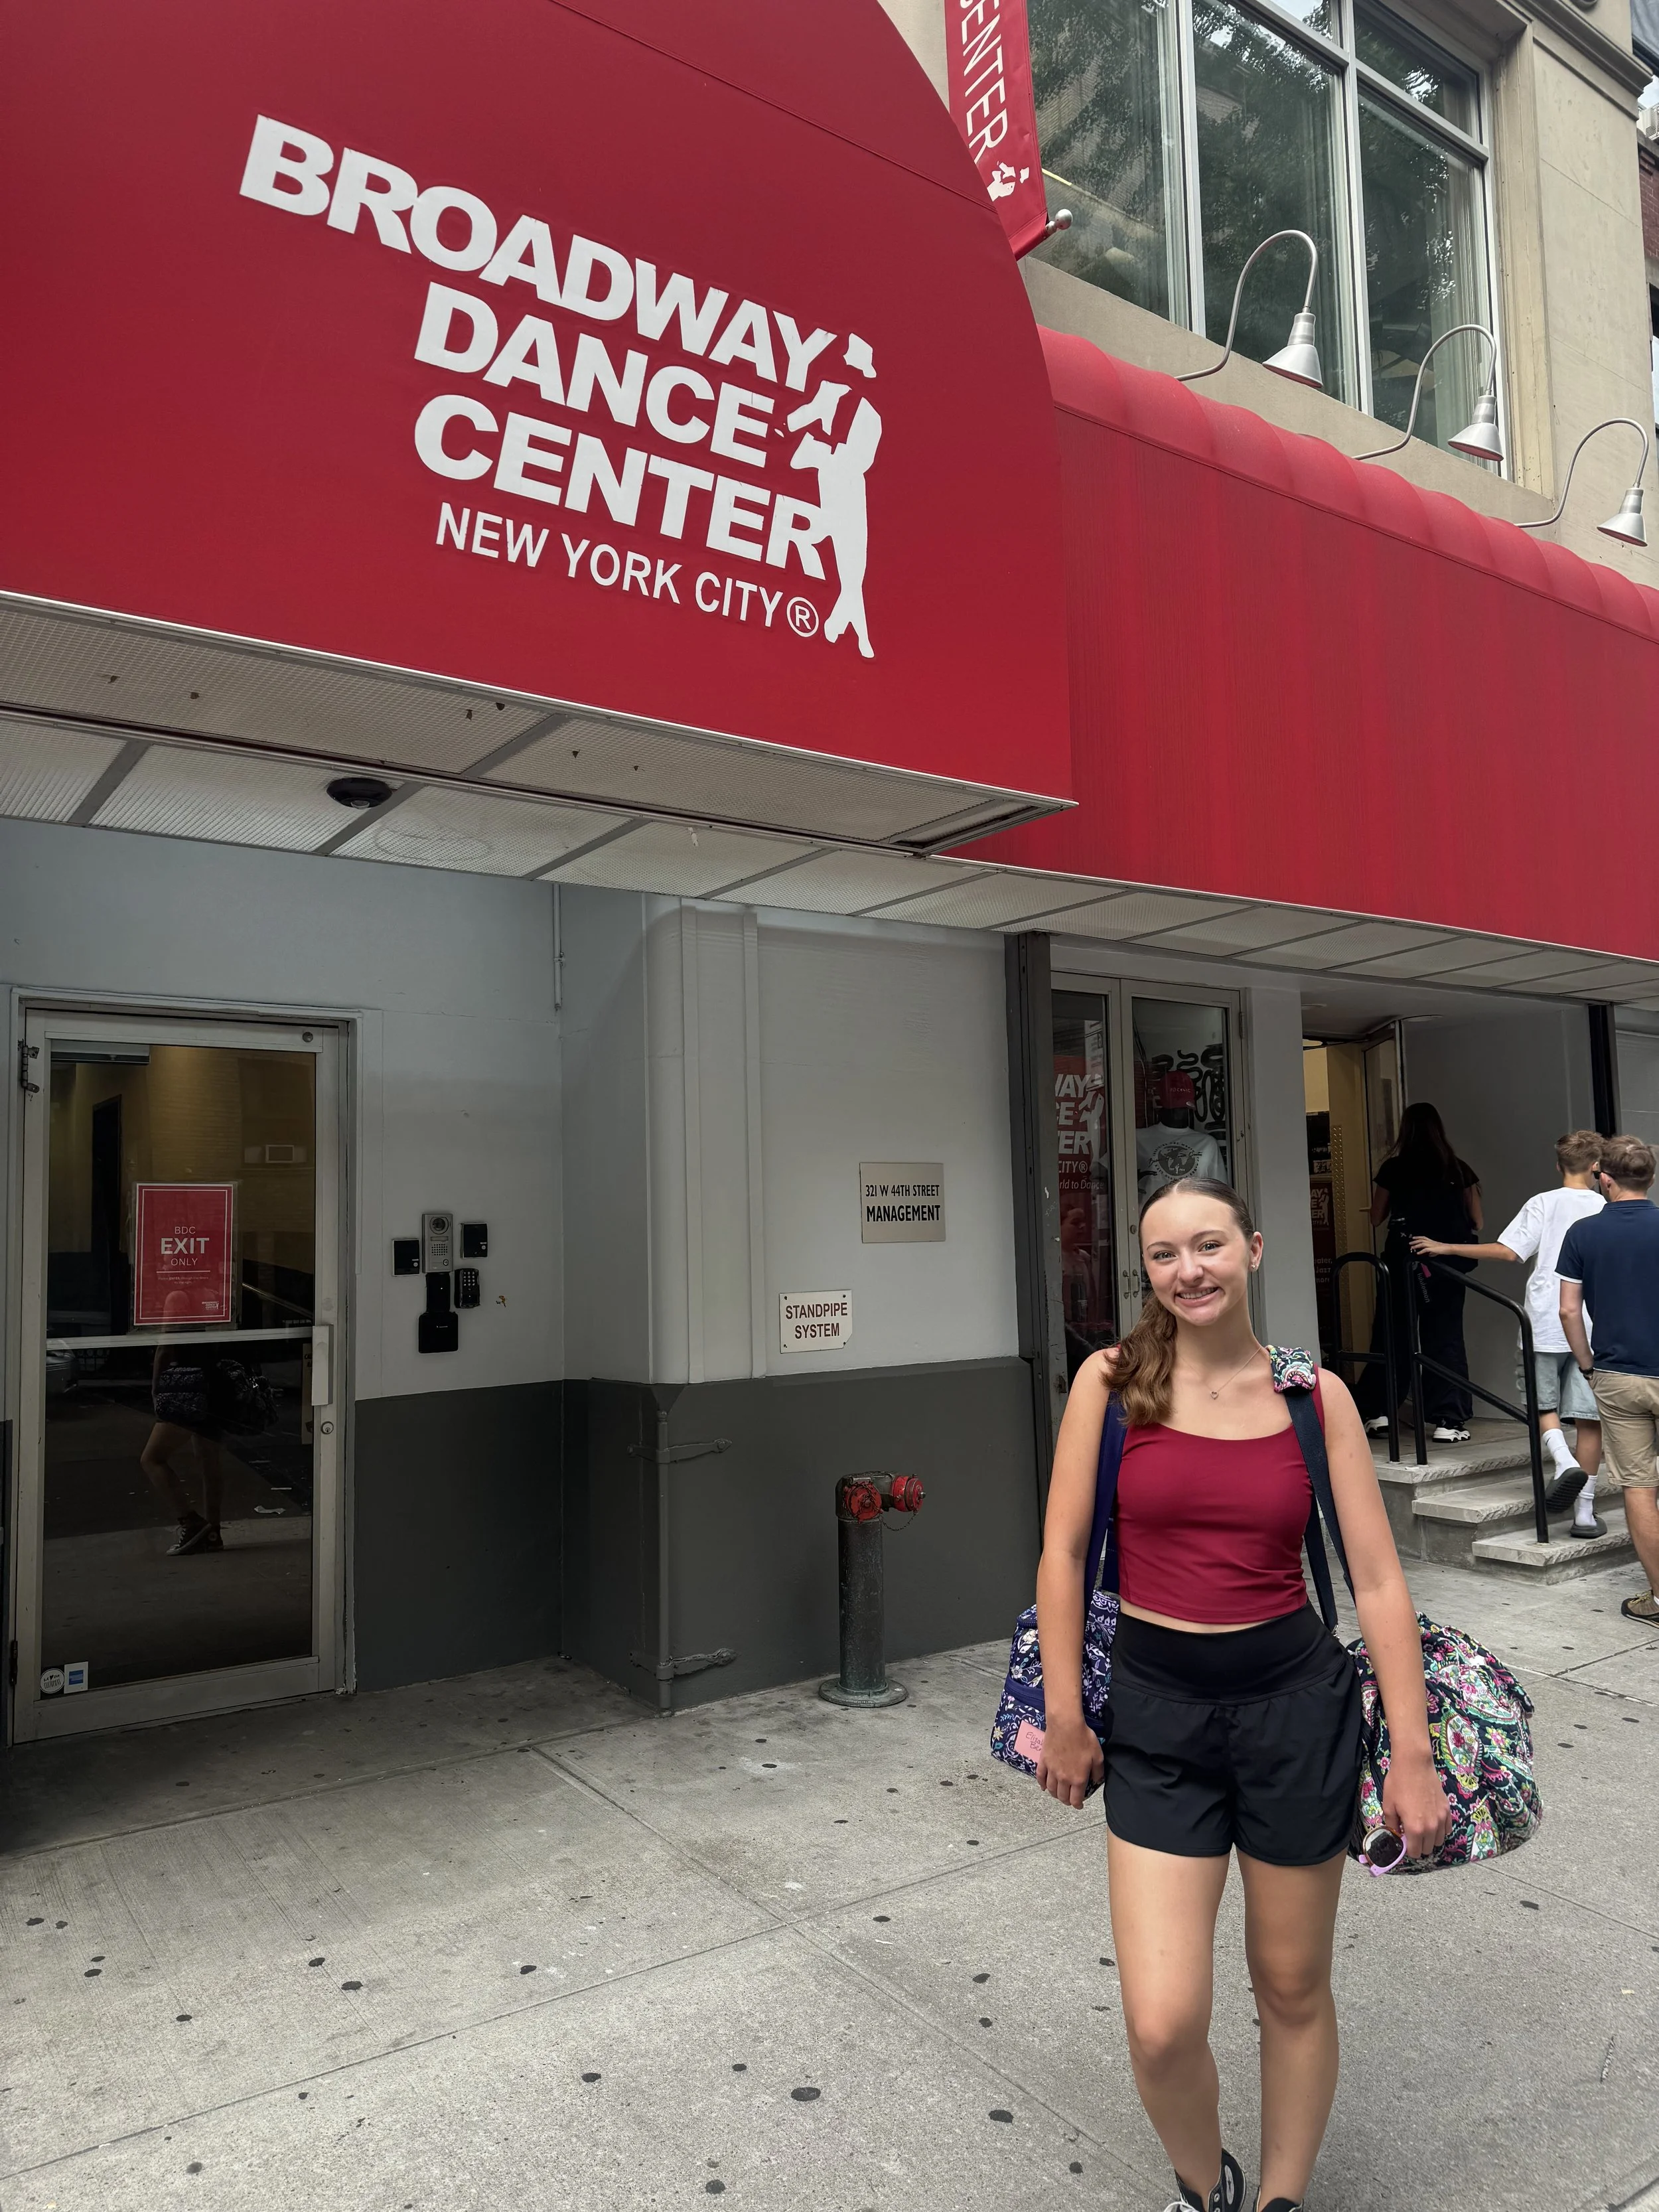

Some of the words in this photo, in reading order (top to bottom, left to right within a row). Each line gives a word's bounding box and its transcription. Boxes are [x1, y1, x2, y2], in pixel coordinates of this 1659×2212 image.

[240, 114, 837, 392] BROADWAY
[414, 282, 774, 468] DANCE
[414, 394, 830, 579] CENTER
[436, 502, 549, 567] NEW
[560, 533, 682, 605] YORK
[865, 1185, 877, 1197] 321
[879, 1185, 889, 1197] W
[891, 1185, 910, 1197] 44TH
[912, 1185, 940, 1197] STREET
[1070, 1180, 1080, 1190] to
[1080, 1179, 1105, 1190] Dance
[866, 1205, 941, 1222] MANAGEMENT
[161, 1237, 210, 1254] EXIT
[786, 1302, 848, 1319] STANDPIPE
[794, 1322, 840, 1339] SYSTEM
